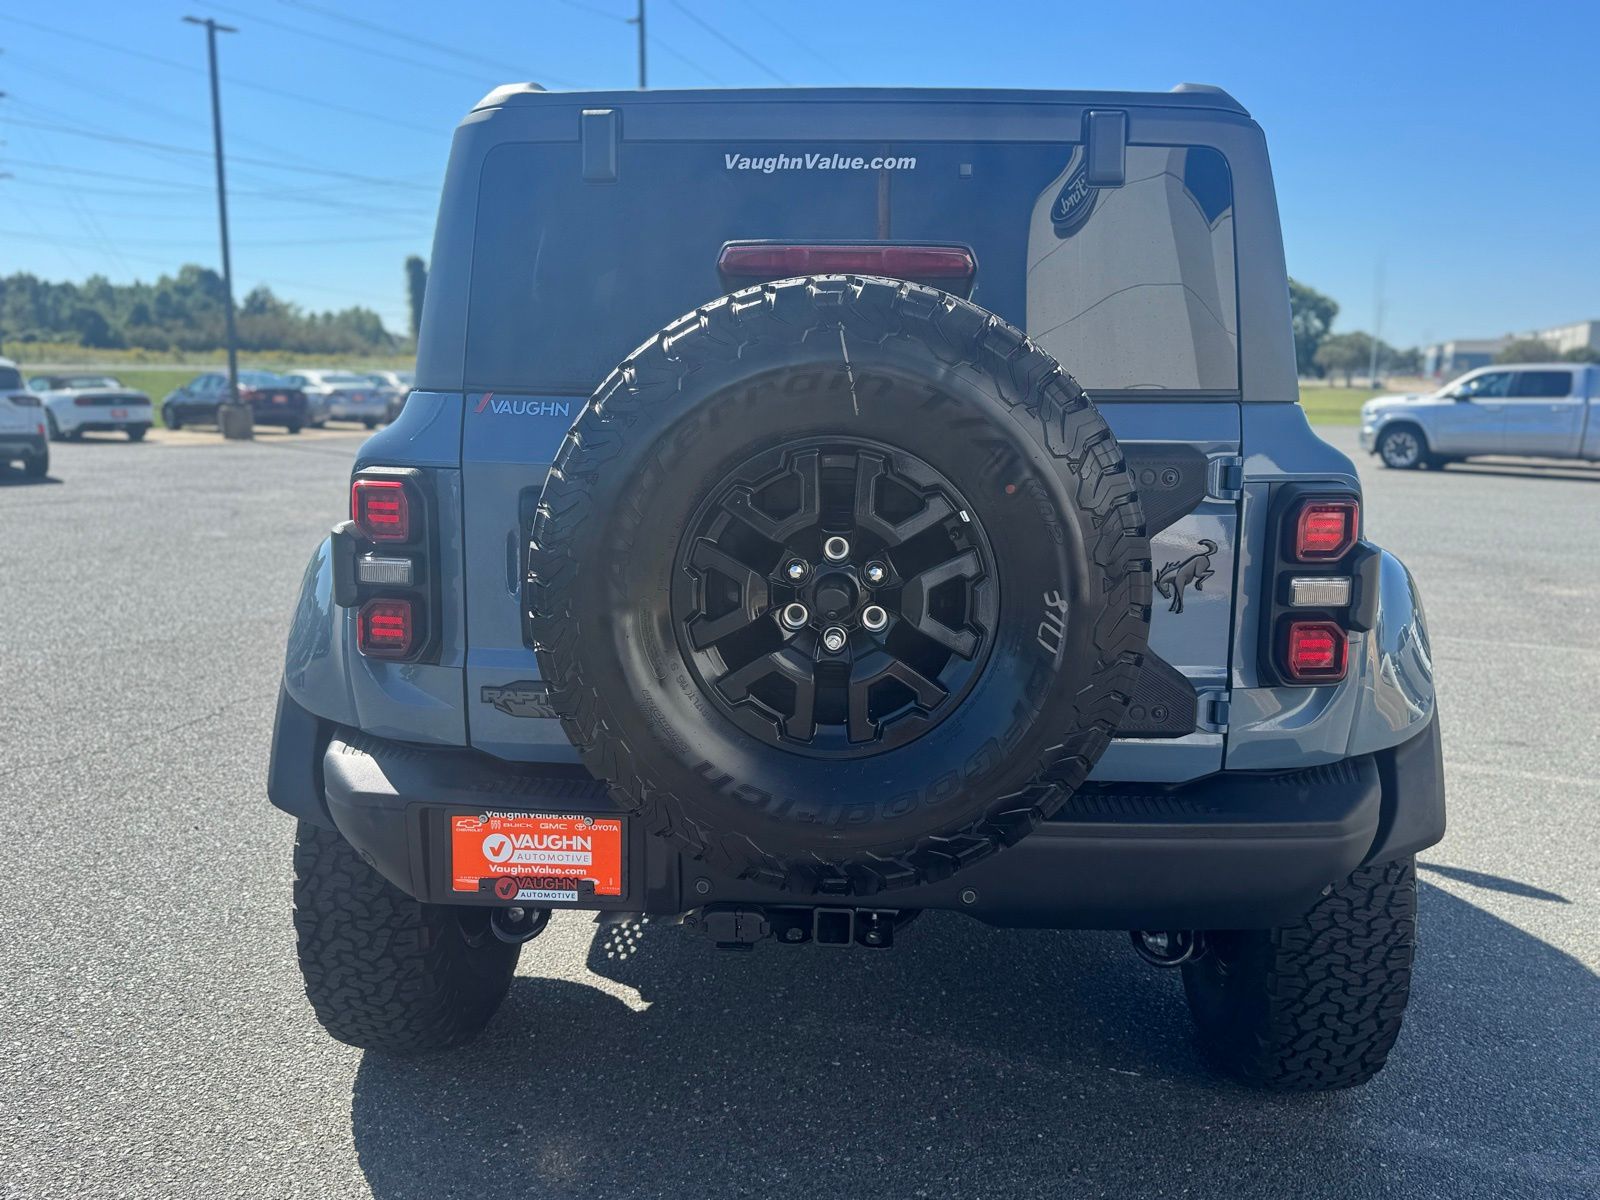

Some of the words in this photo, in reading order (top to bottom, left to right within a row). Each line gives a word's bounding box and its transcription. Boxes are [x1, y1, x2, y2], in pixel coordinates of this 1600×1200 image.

[724, 153, 917, 174] VaughnValue.com
[490, 400, 570, 416] VAUGHN
[539, 822, 568, 830] GMC
[510, 833, 592, 851] VAUGHN
[516, 852, 590, 863] AUTOMOTIVE
[489, 864, 587, 876] VaughnValue.com
[515, 877, 578, 890] VAUGHN
[520, 891, 576, 900] AUTOMOTIVE
